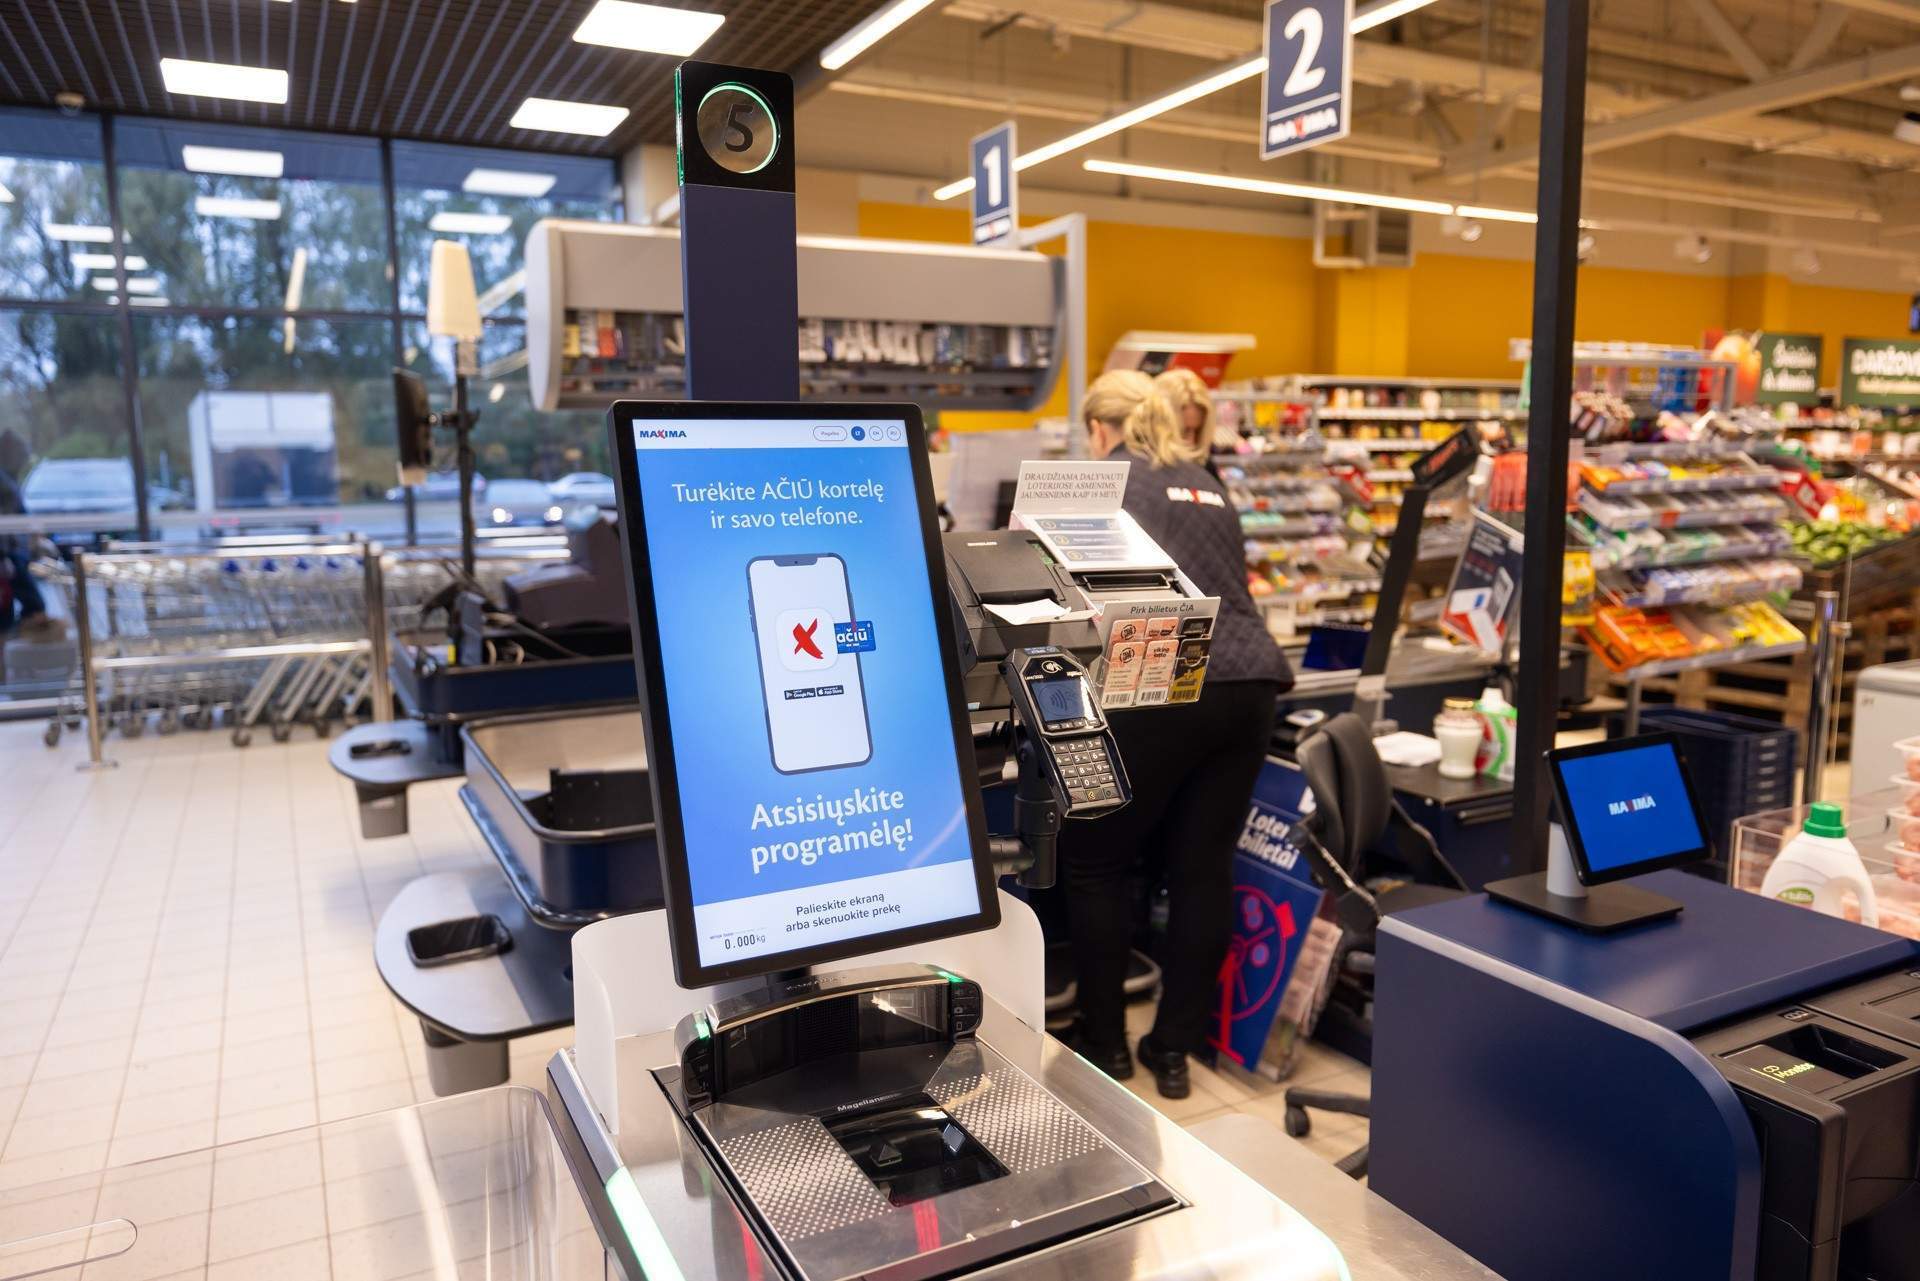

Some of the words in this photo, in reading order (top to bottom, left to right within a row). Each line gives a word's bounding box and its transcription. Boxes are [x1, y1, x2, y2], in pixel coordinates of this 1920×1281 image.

[1283, 7, 1326, 97] 2
[724, 103, 753, 152] 5
[982, 145, 1002, 207] 1
[640, 429, 687, 439] MAXIMA
[672, 481, 756, 502] Turėkite
[762, 477, 812, 500] AČIŪ
[819, 479, 884, 502] kortelę
[710, 510, 724, 529] ir
[731, 512, 776, 528] savo
[781, 506, 863, 526] telefone.
[1130, 606, 1147, 614] Pirk
[1148, 605, 1178, 614] bilietus
[1180, 602, 1194, 612] ČIA
[836, 628, 868, 643] ačiū
[751, 786, 904, 830] Atsisiųskite
[1608, 796, 1656, 816] MAXIMA
[1245, 806, 1290, 839] Loter
[751, 818, 913, 874] programėlę!
[1237, 827, 1300, 871] bilietai
[796, 899, 847, 916] Palieskite
[850, 892, 884, 906] ekraną
[786, 918, 810, 932] arba
[812, 908, 869, 928] skenuokite
[872, 902, 901, 918] prekę
[724, 934, 756, 950] 0.000
[837, 1096, 880, 1112] Magellan
